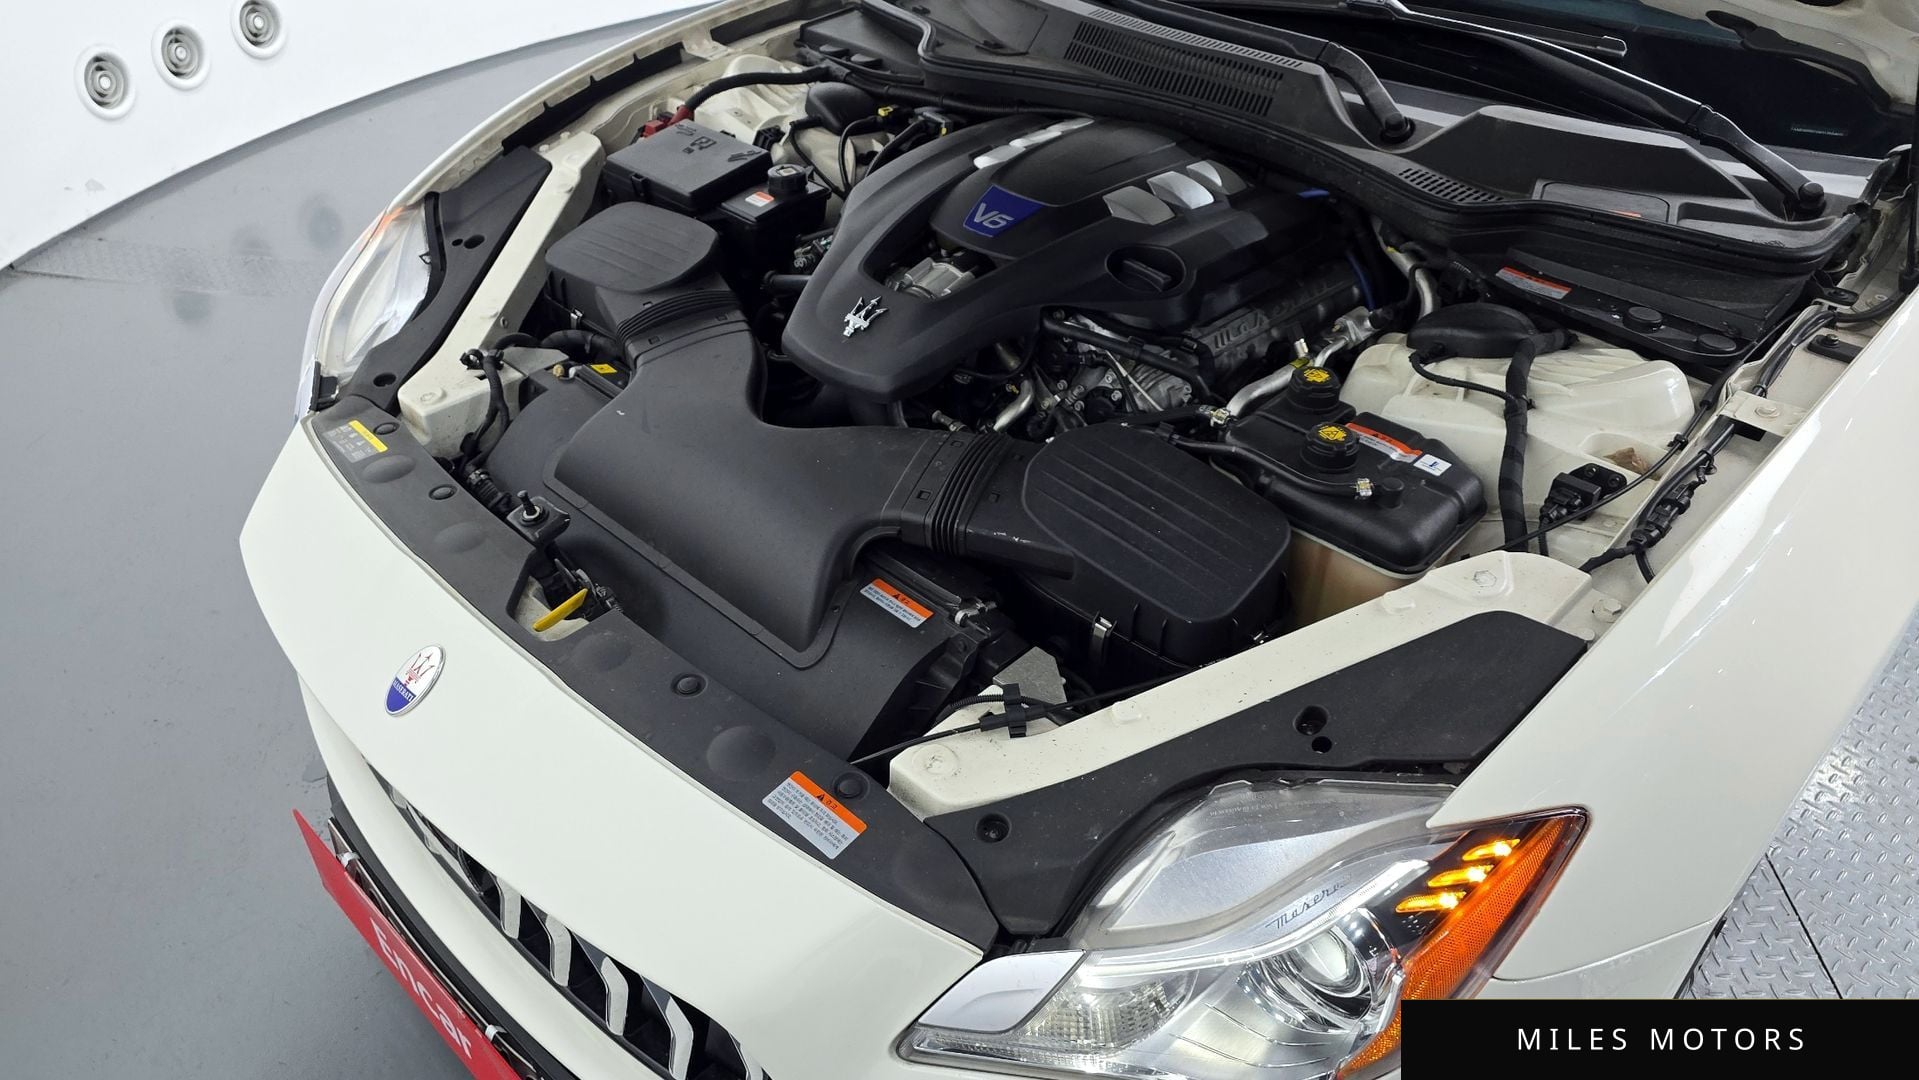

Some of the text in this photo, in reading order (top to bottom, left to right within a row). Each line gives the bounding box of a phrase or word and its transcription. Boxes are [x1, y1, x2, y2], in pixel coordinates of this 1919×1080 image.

[974, 202, 1015, 229] V6
[392, 680, 414, 702] MASERATI
[1265, 873, 1352, 929] Masera
[370, 917, 472, 1059] Encar
